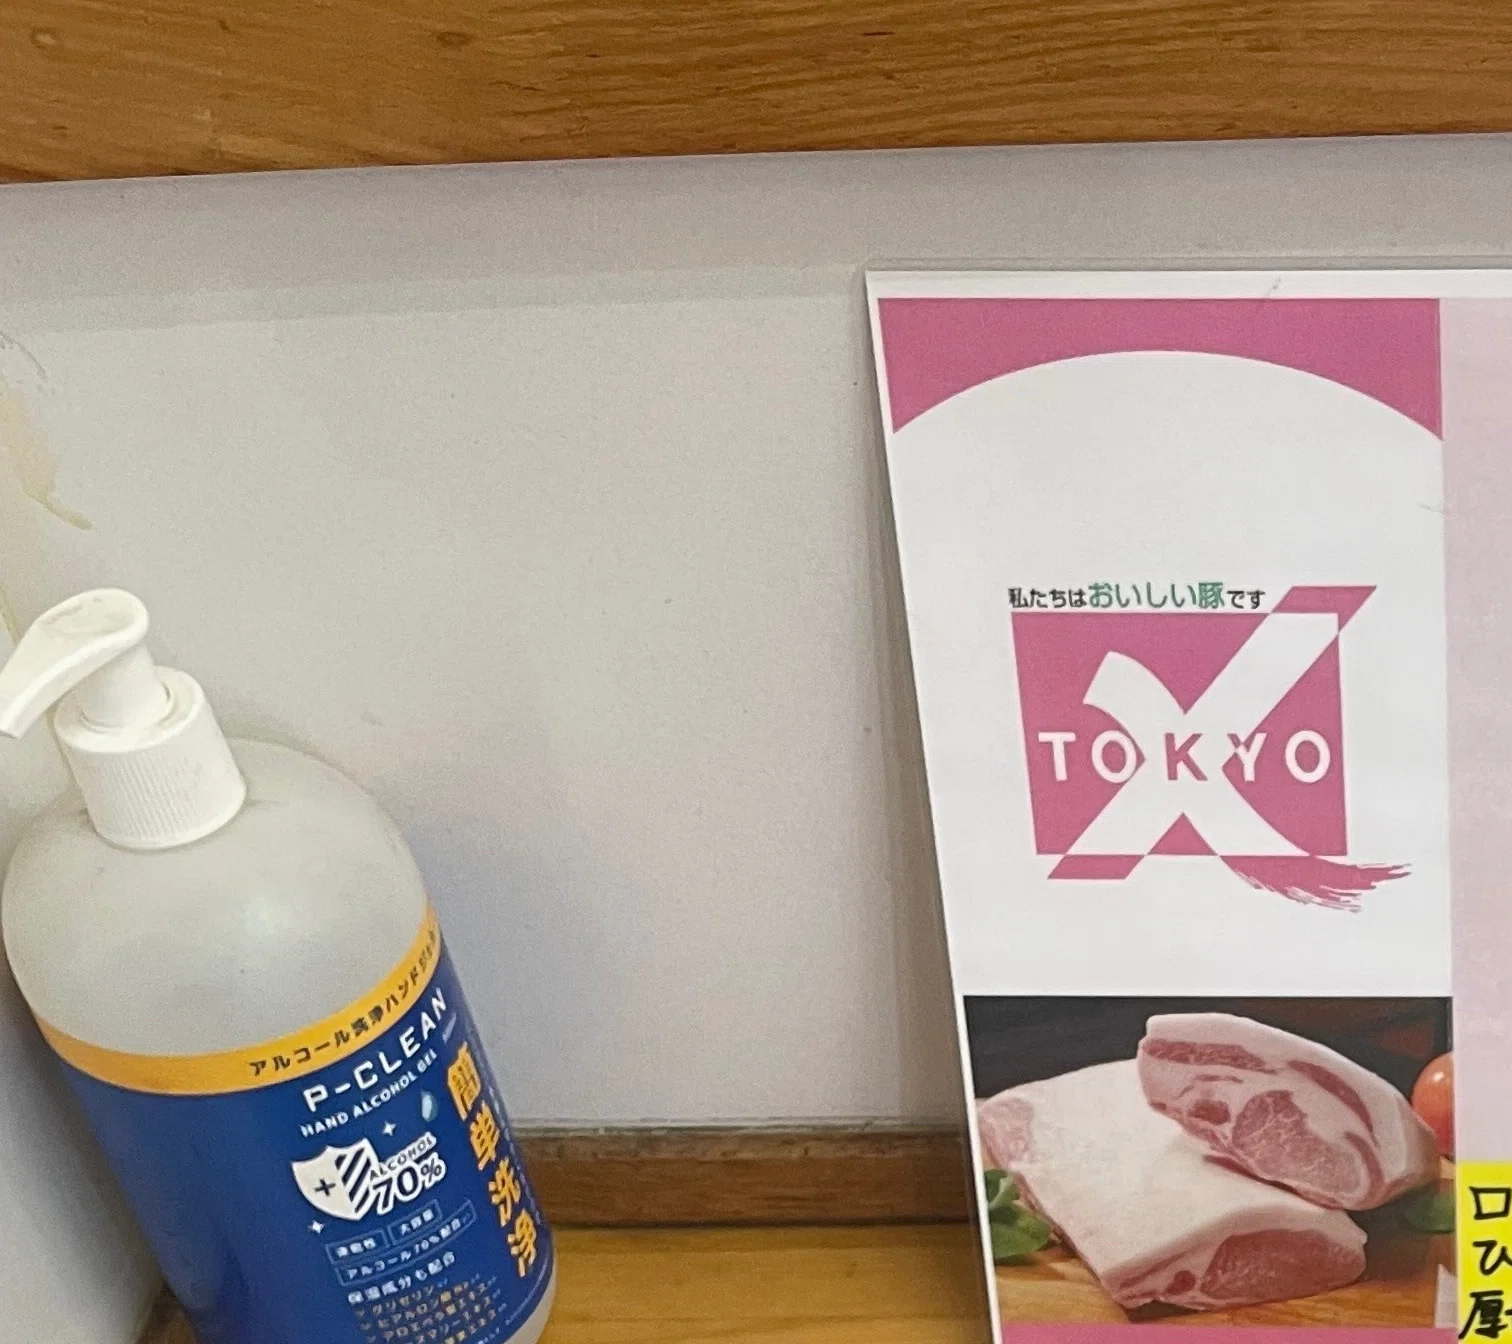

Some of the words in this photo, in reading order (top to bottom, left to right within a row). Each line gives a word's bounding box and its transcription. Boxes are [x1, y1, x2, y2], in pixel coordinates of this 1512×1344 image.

[1038, 730, 1331, 783] TOKYO
[303, 987, 447, 1113] P-CLEAN
[300, 1111, 349, 1138] HAND
[352, 1070, 418, 1119] ALCOHOL
[369, 1136, 433, 1181] ALCOHOL
[372, 1158, 443, 1211] 70%
